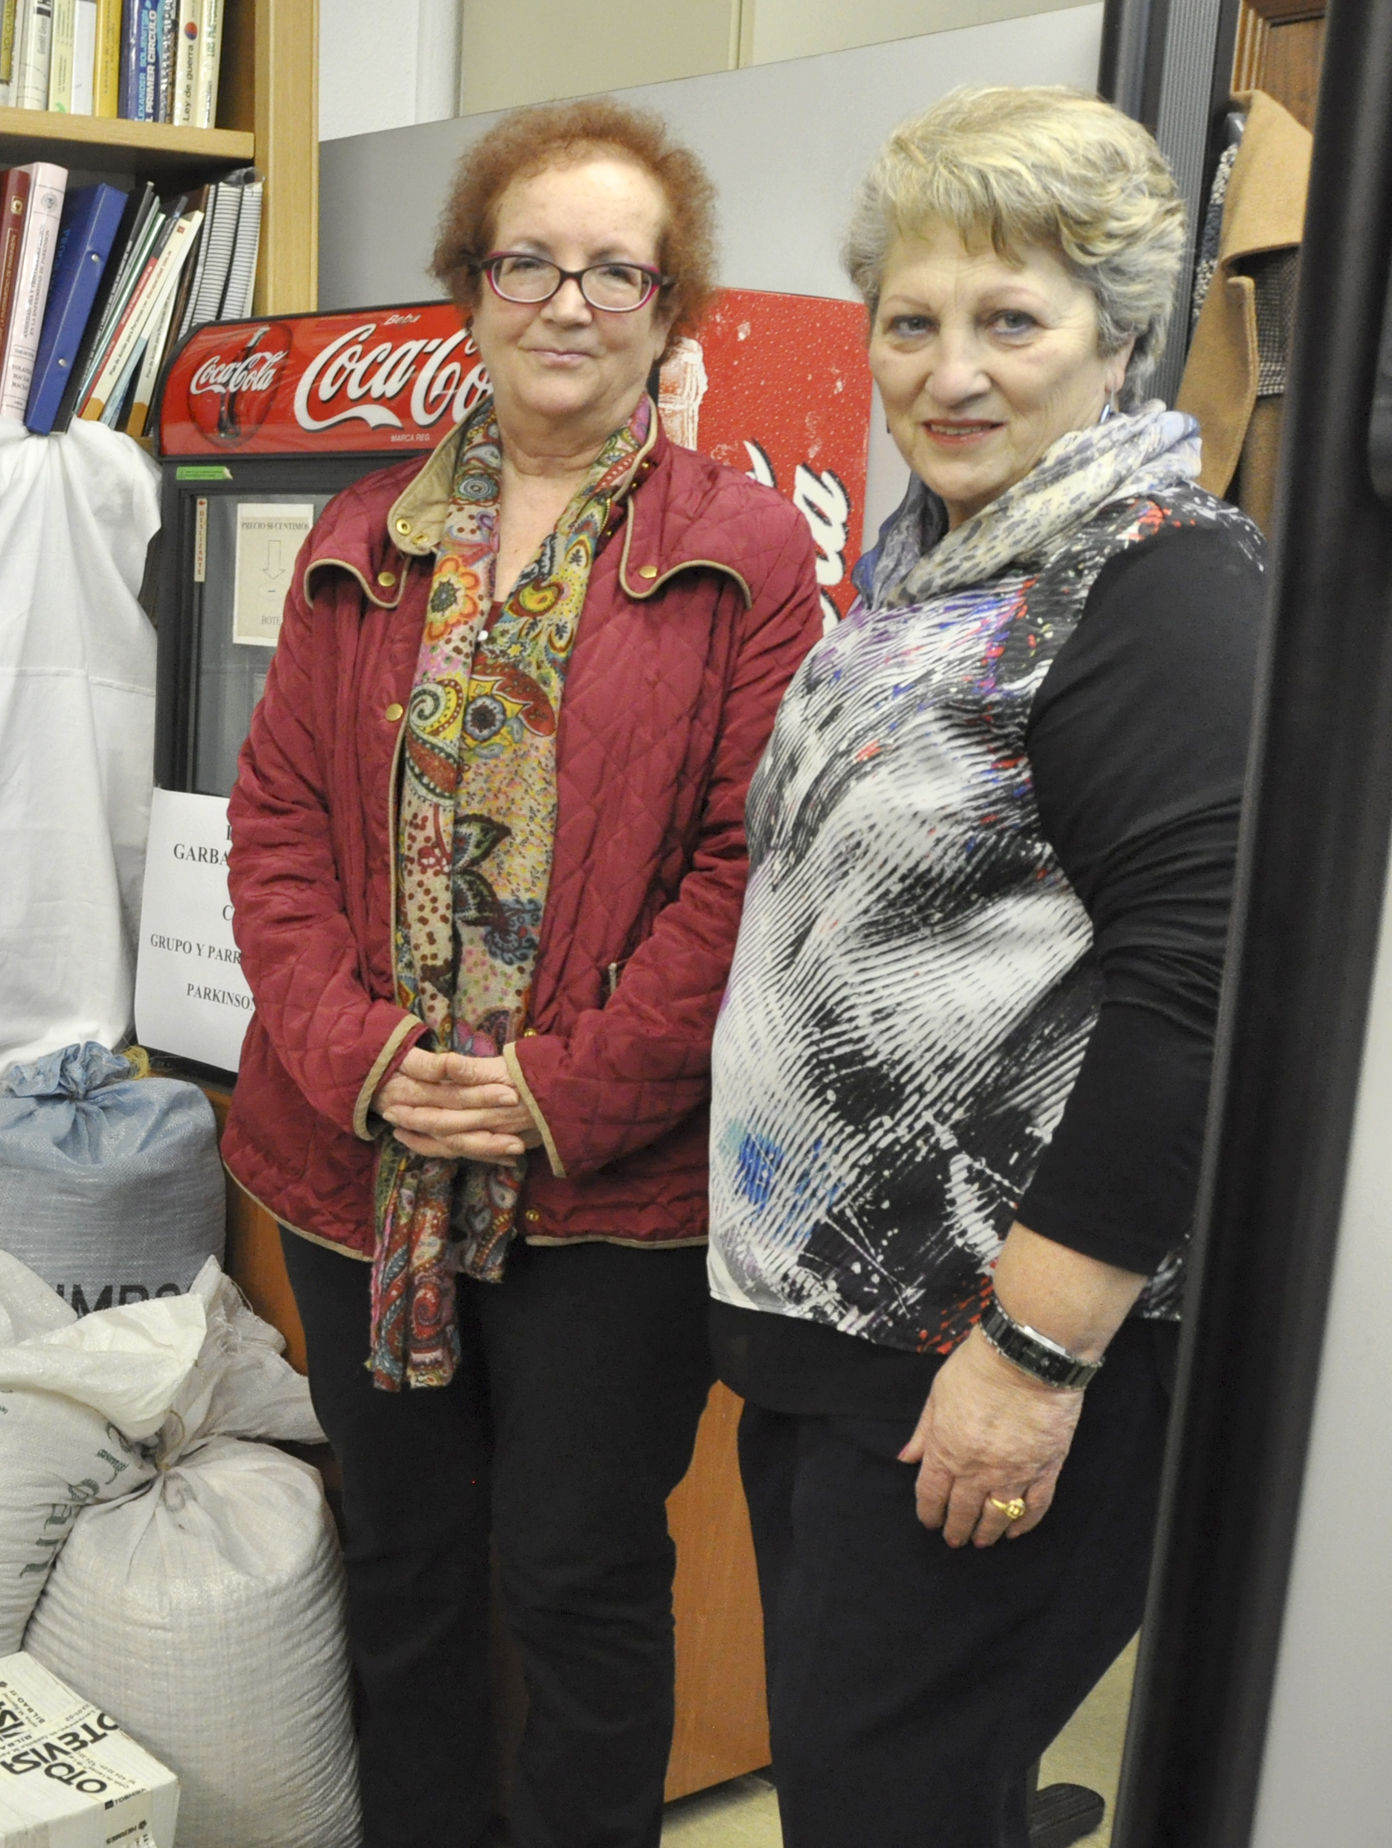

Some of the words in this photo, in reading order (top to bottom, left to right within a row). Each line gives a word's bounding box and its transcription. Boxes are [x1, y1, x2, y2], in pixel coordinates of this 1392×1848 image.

[147, 10, 158, 64] CIRCULO
[185, 44, 194, 81] guerra
[146, 65, 156, 114] PRIMER
[184, 84, 192, 98] de
[182, 101, 192, 122] Ley
[30, 274, 44, 317] ENFERMEDAD
[39, 229, 52, 265] PARKINSON
[116, 341, 129, 359] Acción
[130, 307, 145, 332] Personas
[144, 266, 165, 301] discapacidad
[383, 313, 422, 327] Beba
[389, 433, 415, 443] MARCA
[240, 521, 266, 531] PRECIO
[274, 521, 310, 531] CENTIMOS
[150, 933, 193, 955] GRUPO
[195, 942, 206, 958] Y
